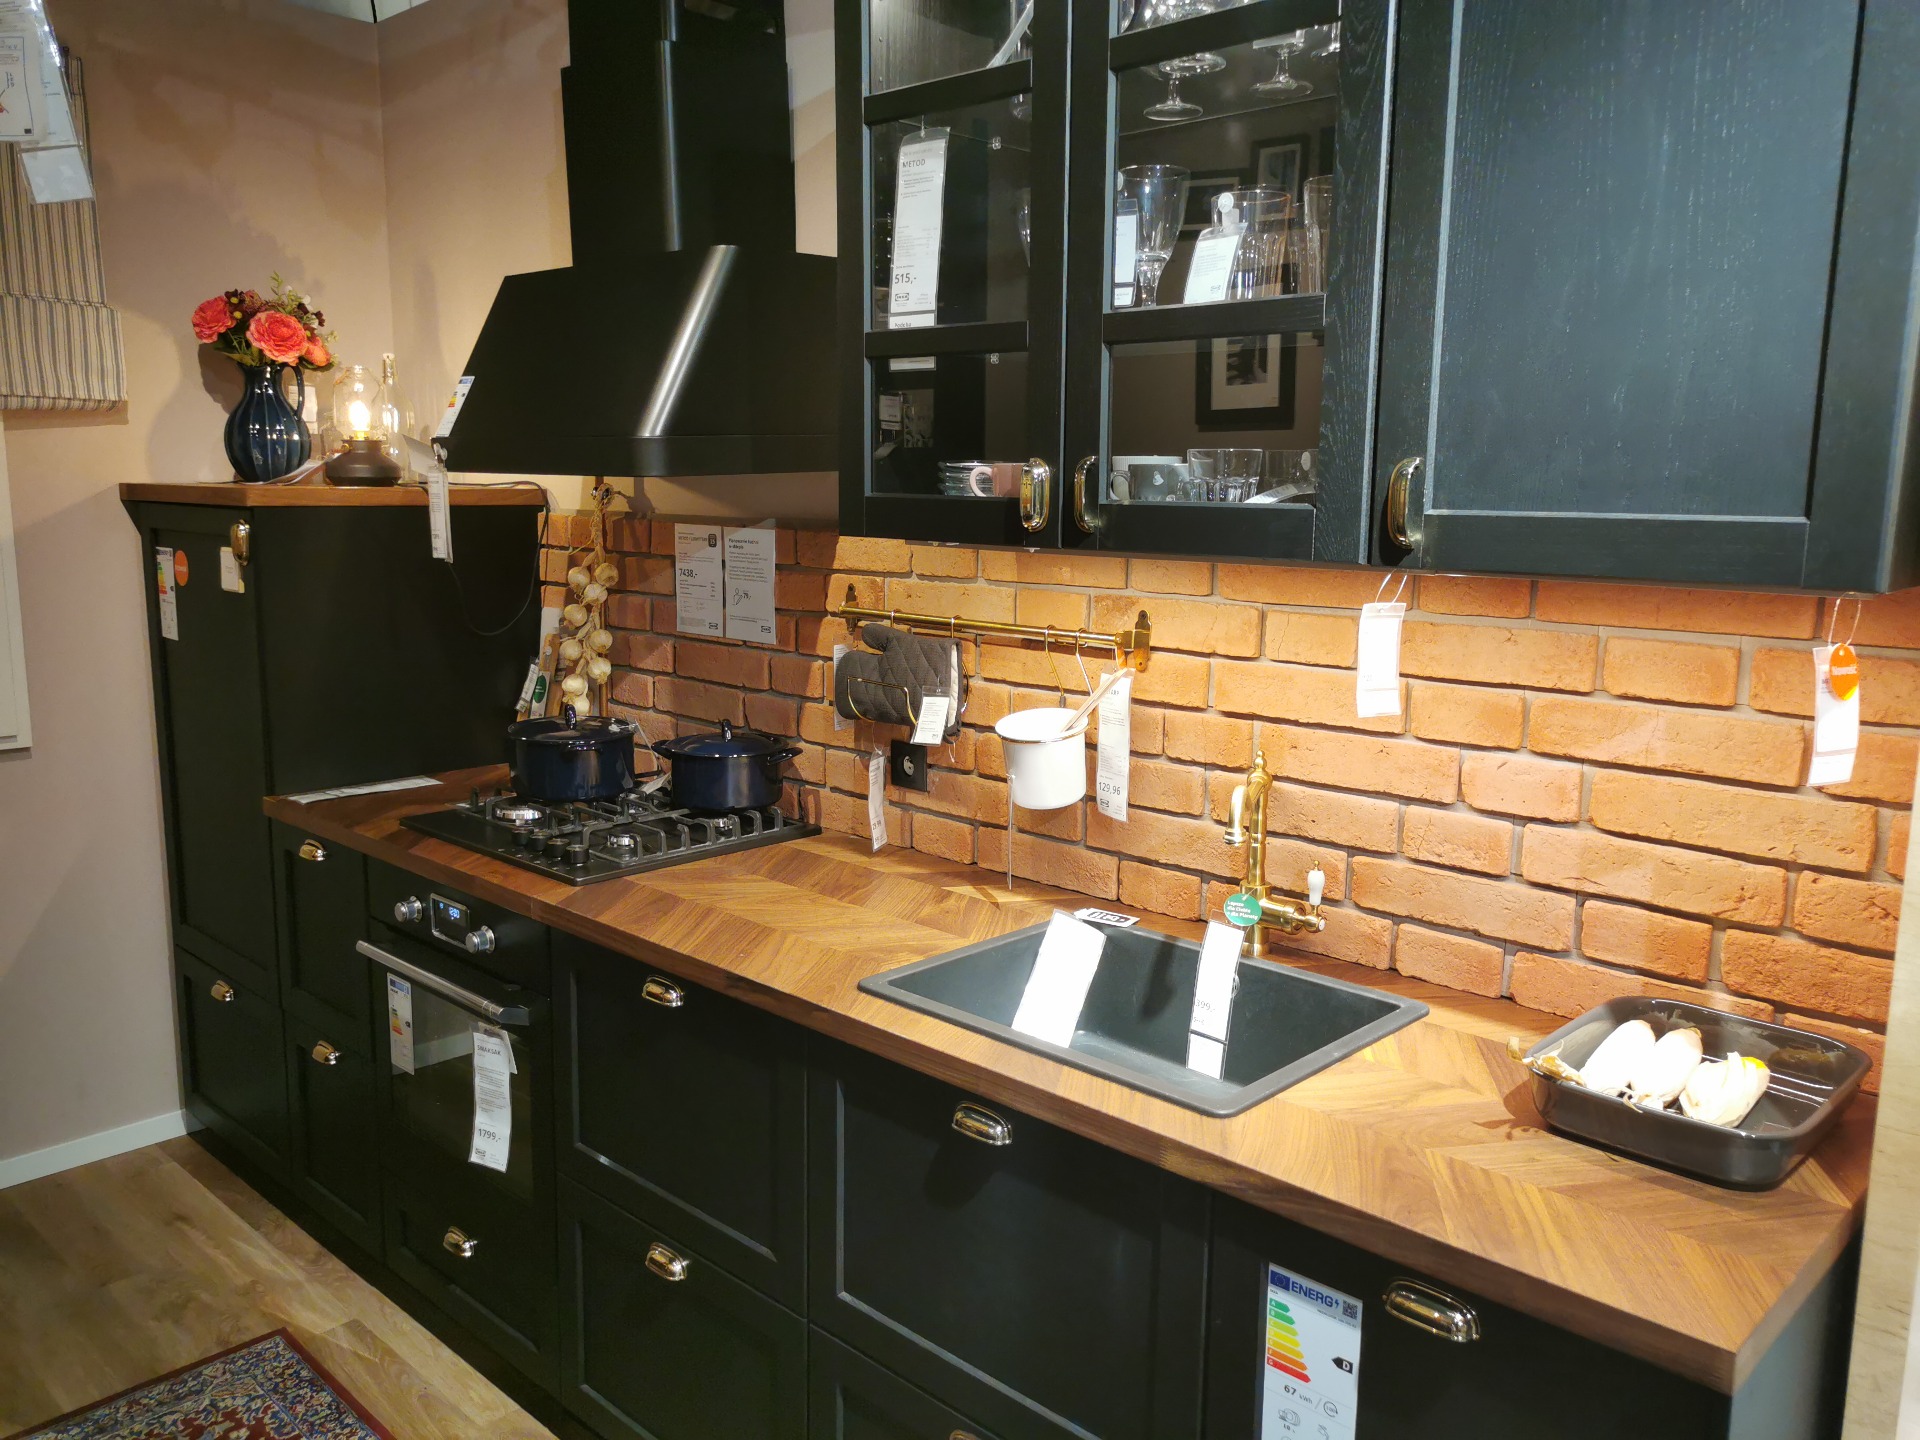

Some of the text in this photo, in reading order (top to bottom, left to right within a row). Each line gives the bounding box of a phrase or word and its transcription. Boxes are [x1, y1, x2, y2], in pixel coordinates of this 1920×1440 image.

[902, 159, 926, 168] METOD
[894, 273, 917, 285] 515,-
[679, 568, 698, 579] 7438,-
[1099, 781, 1121, 796] 129,96
[478, 1128, 501, 1142] 1799,-
[1291, 1280, 1334, 1308] ENERG
[1342, 1360, 1351, 1371] D
[1284, 1384, 1297, 1396] 67
